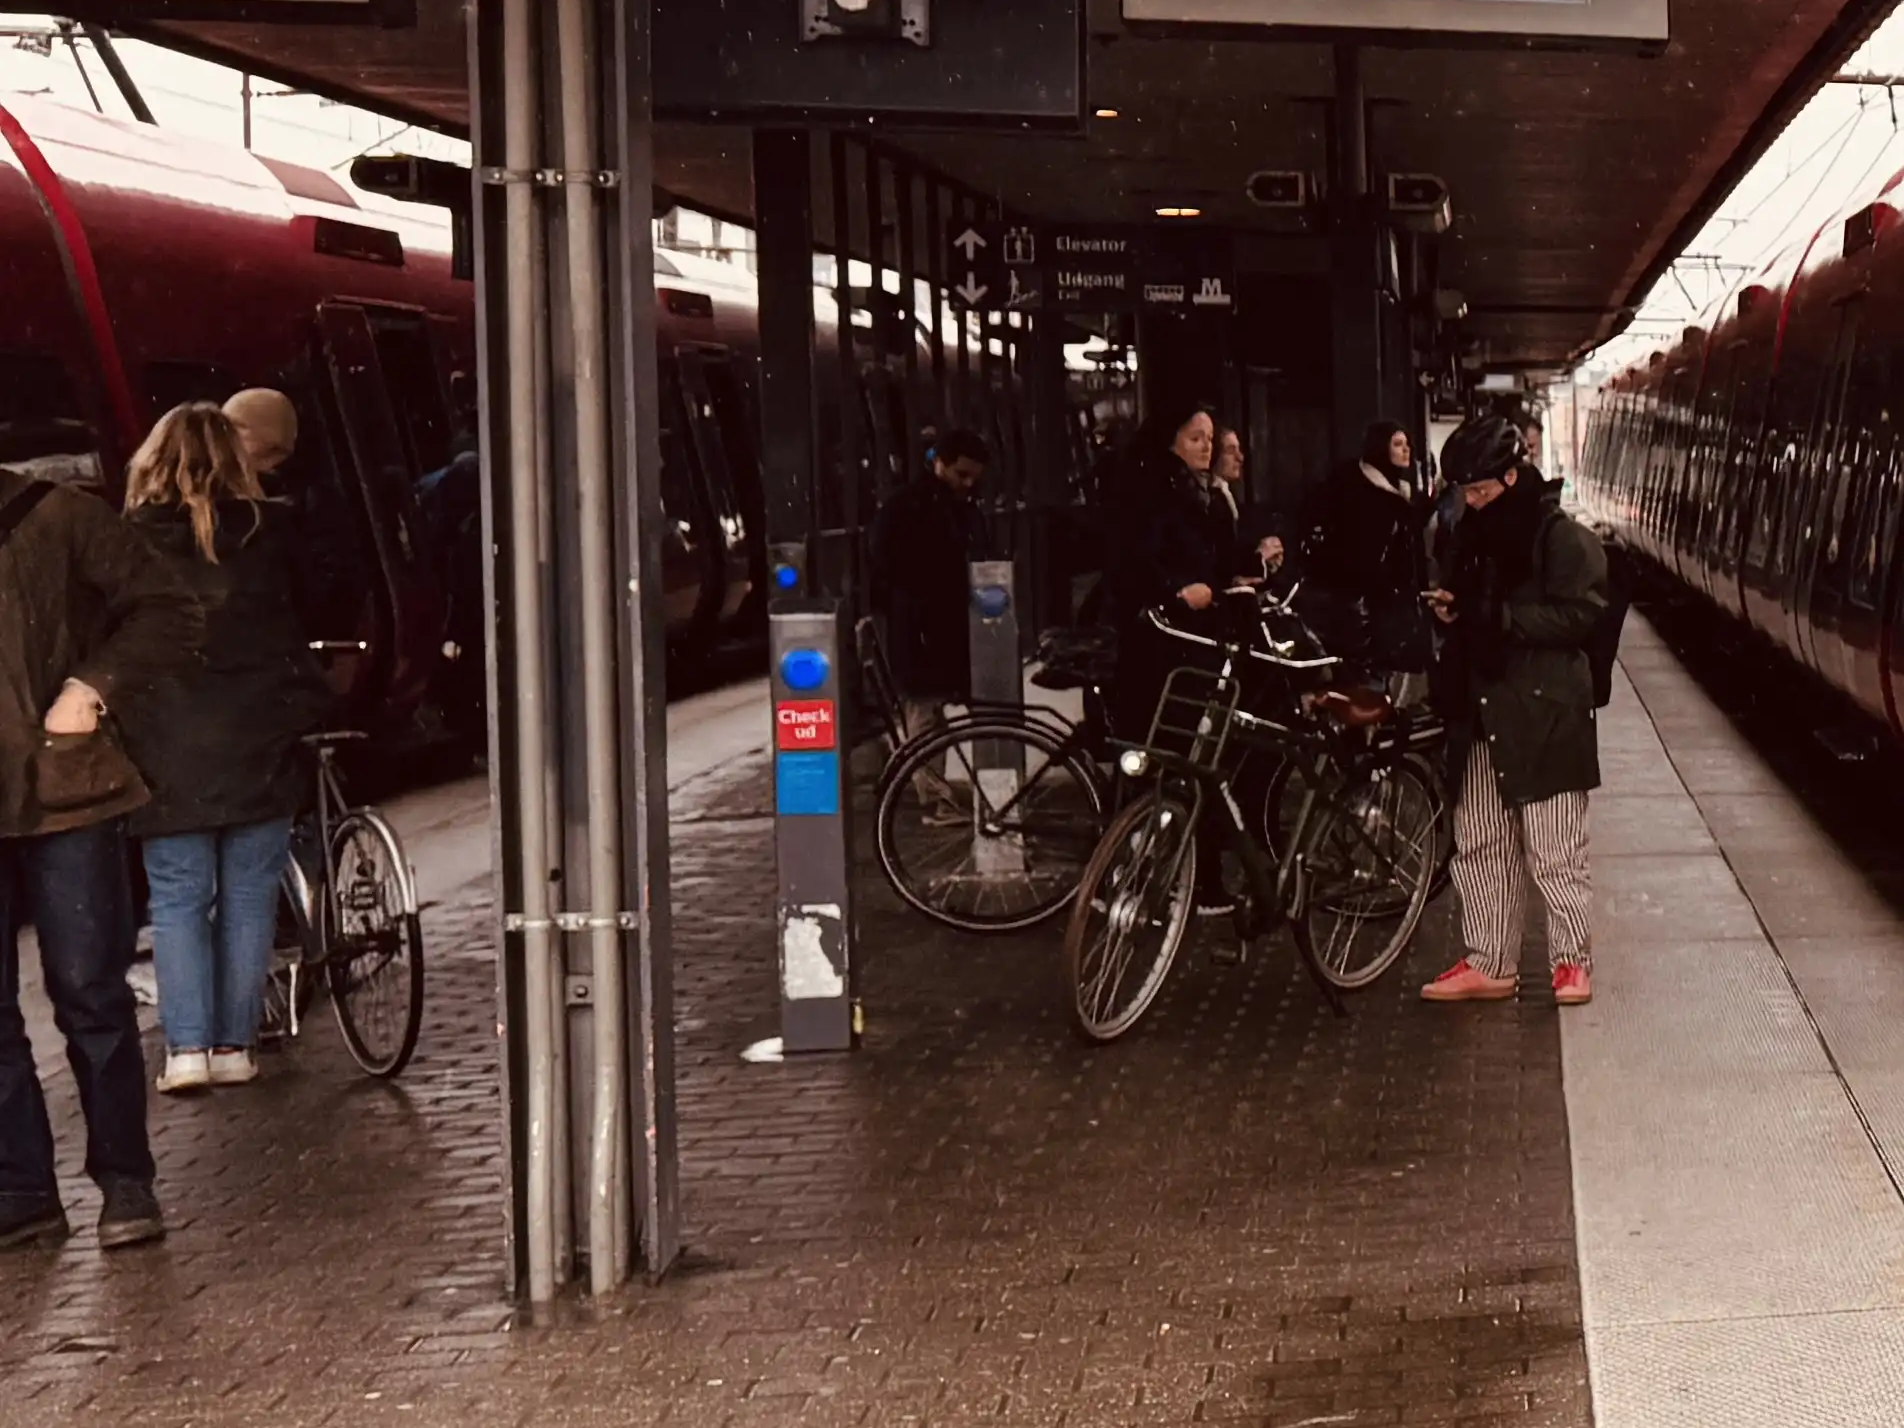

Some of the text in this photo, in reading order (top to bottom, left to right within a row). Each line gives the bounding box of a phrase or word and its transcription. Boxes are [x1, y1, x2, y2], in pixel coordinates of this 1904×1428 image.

[1056, 236, 1126, 252] Elevator
[1058, 271, 1125, 289] Udgang
[778, 708, 831, 725] Check
[794, 724, 817, 740] ud
